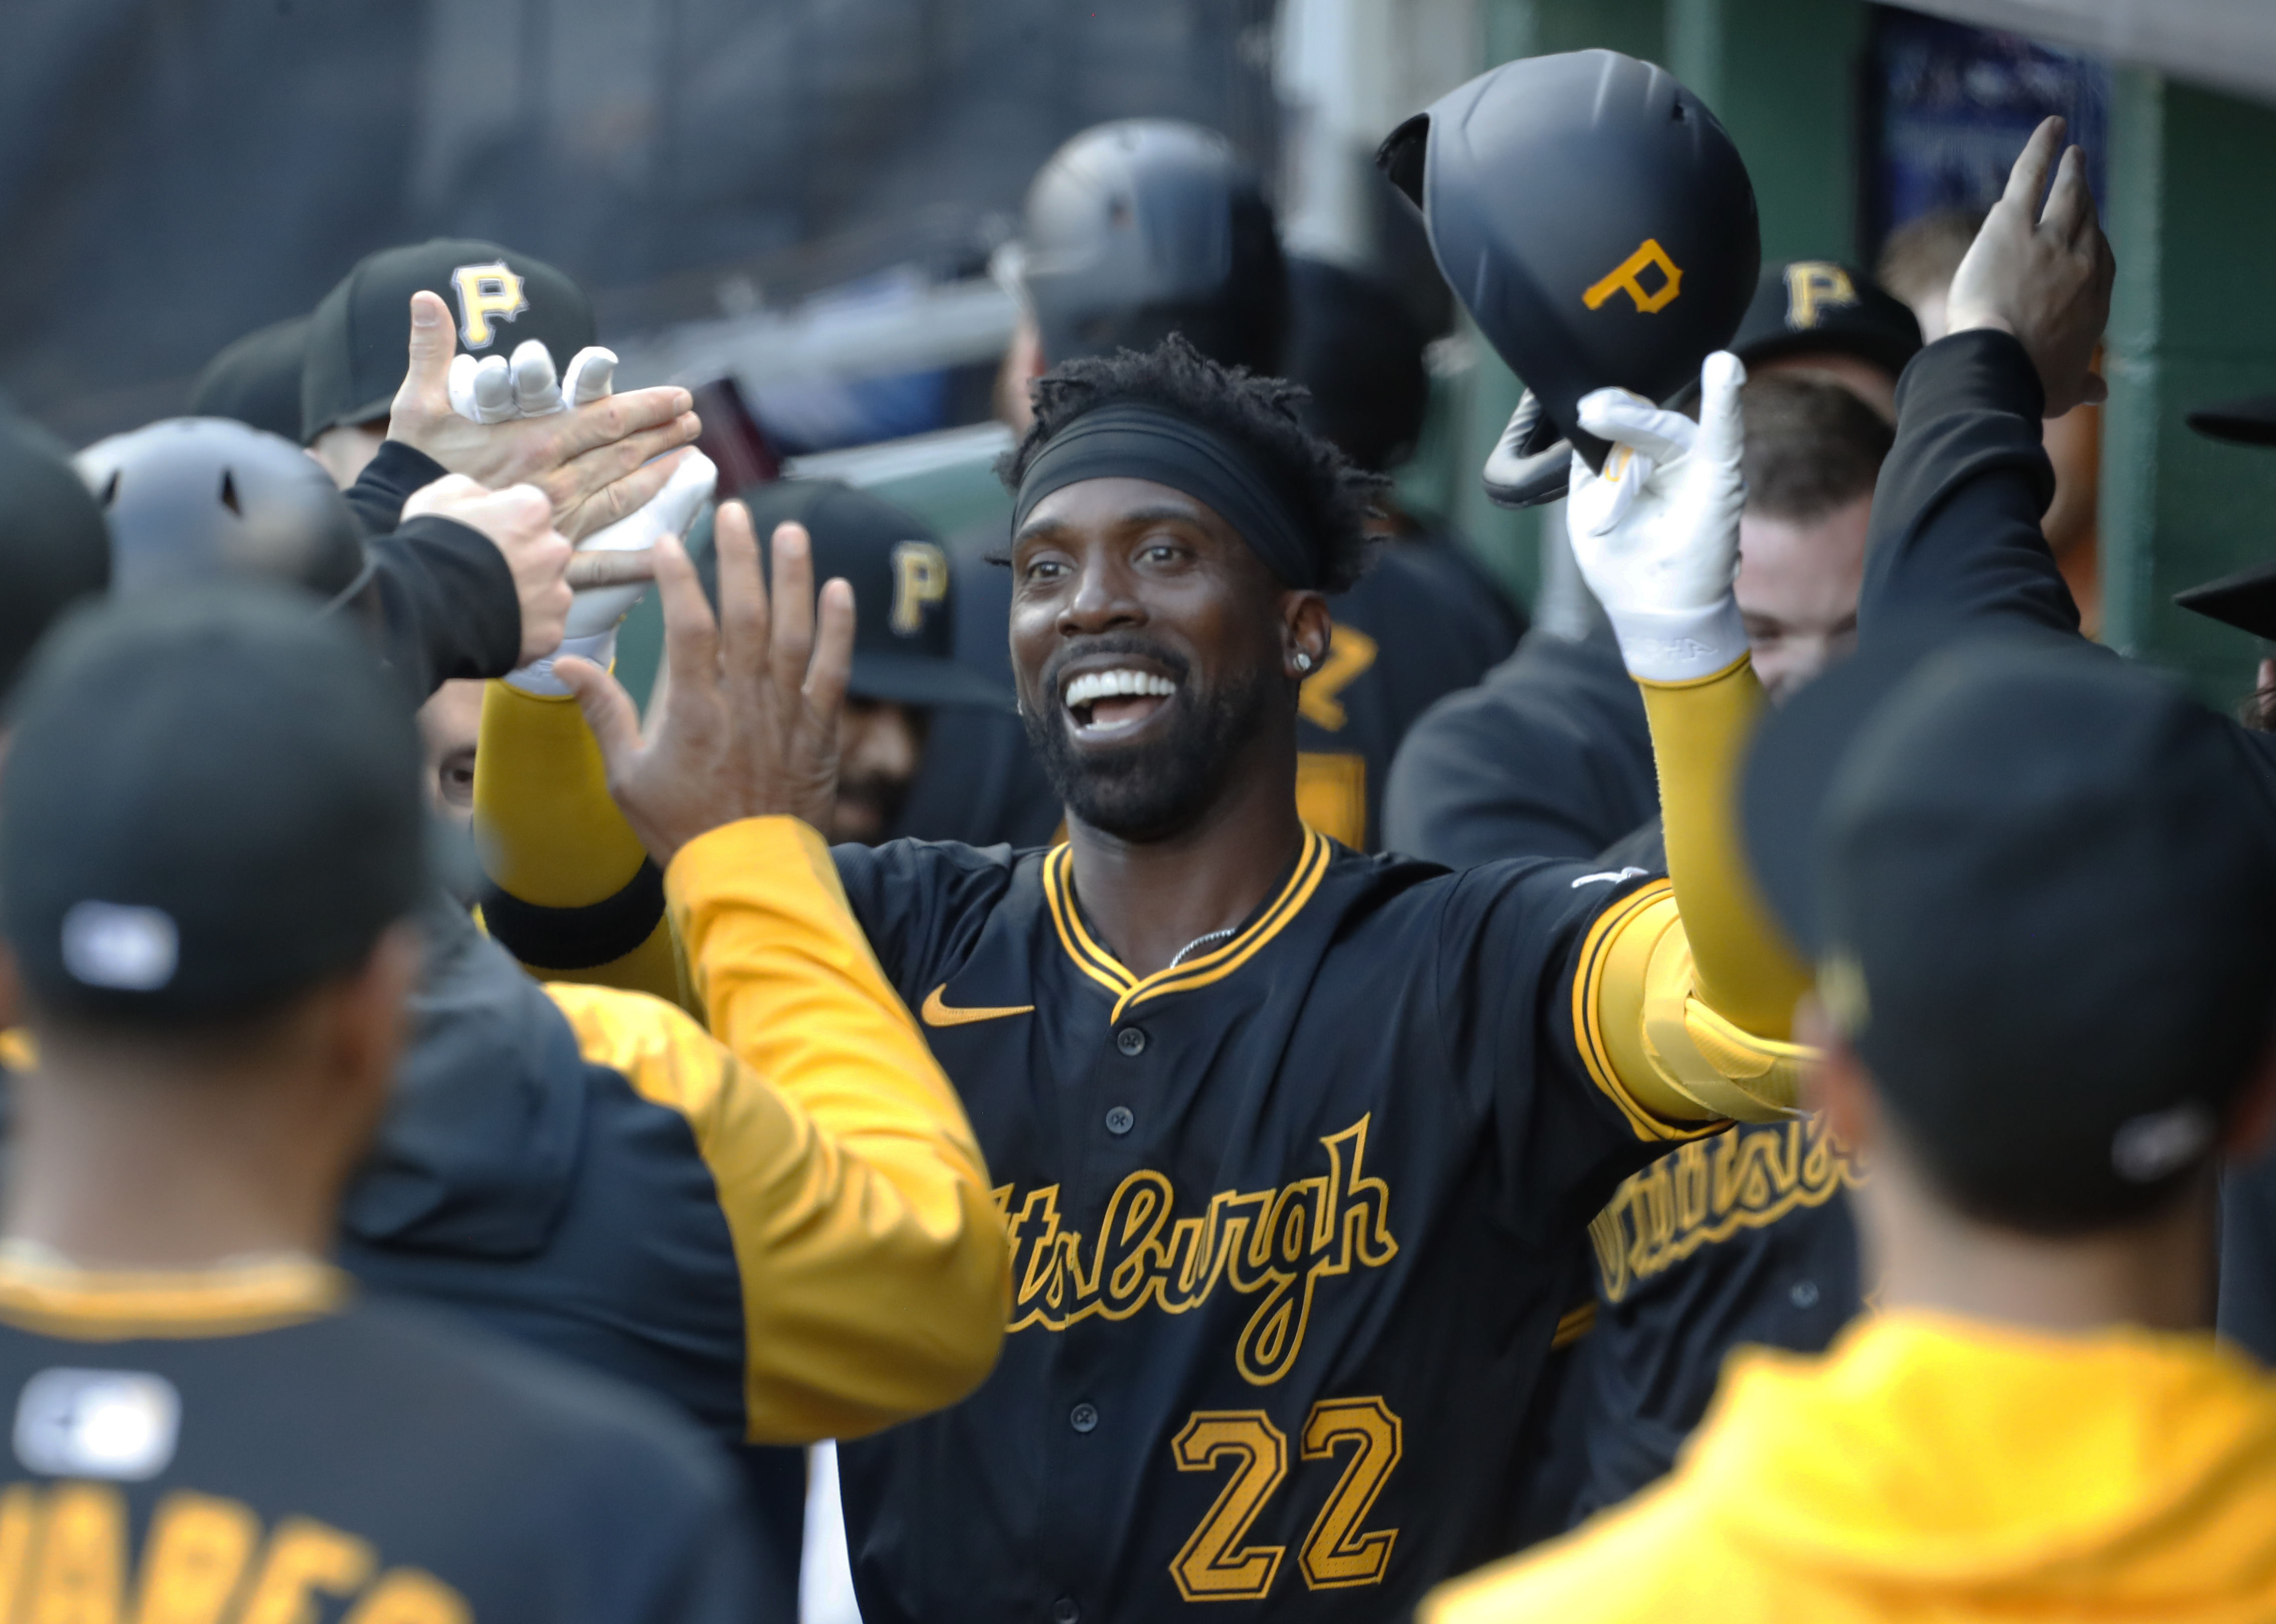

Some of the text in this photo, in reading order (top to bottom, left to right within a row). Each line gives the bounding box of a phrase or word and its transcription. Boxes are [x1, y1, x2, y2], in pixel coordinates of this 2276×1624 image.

[451, 257, 529, 350] P
[1582, 238, 1683, 313] P
[1783, 261, 1858, 331] P
[888, 539, 949, 637] P
[1169, 1396, 1402, 1601] 22
